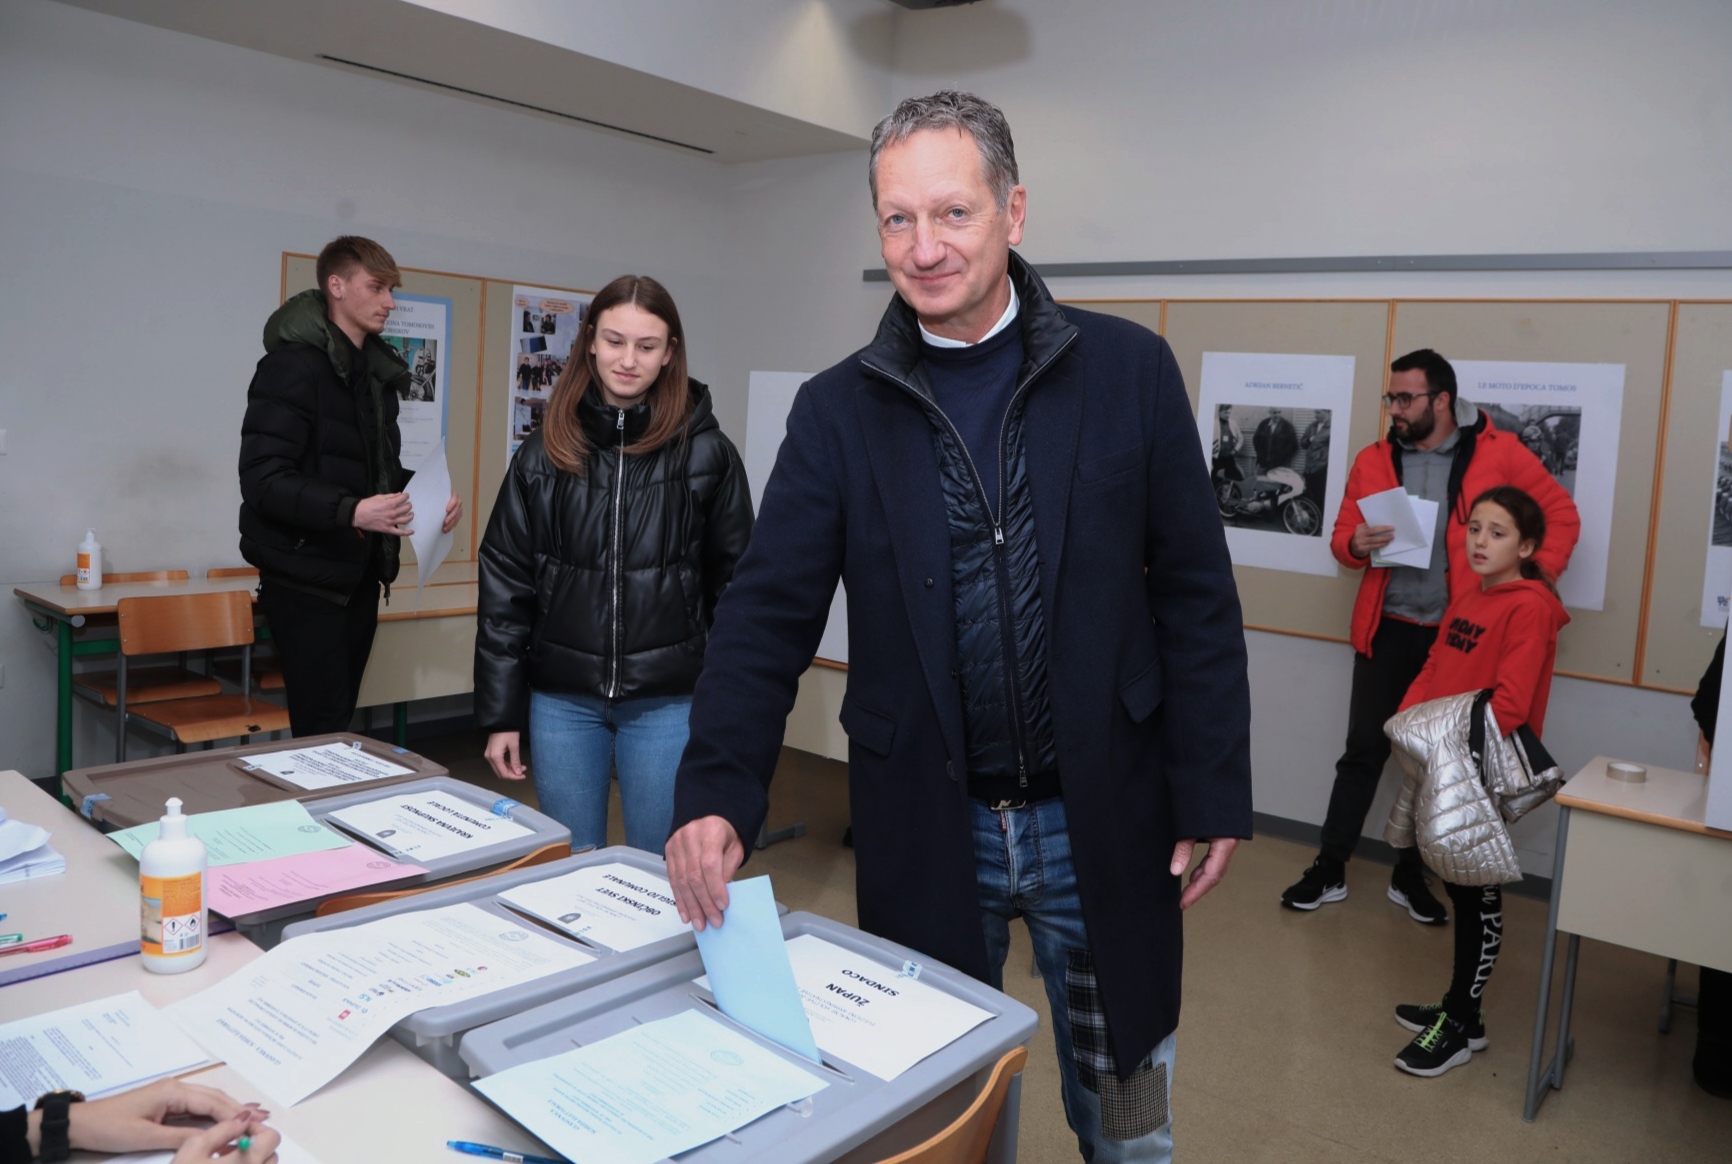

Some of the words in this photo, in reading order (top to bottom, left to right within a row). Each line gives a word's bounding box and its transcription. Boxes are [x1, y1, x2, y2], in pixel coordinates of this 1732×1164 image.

[1488, 382, 1512, 390] MOTO
[1548, 384, 1577, 392] TOMOS
[594, 888, 620, 900] SVET
[602, 873, 651, 894] COMUNALE
[616, 894, 661, 916] OBČINSKI
[647, 892, 677, 906] SIGLIO
[841, 969, 900, 997] SINDACO
[826, 983, 870, 1008] ŽUPAN
